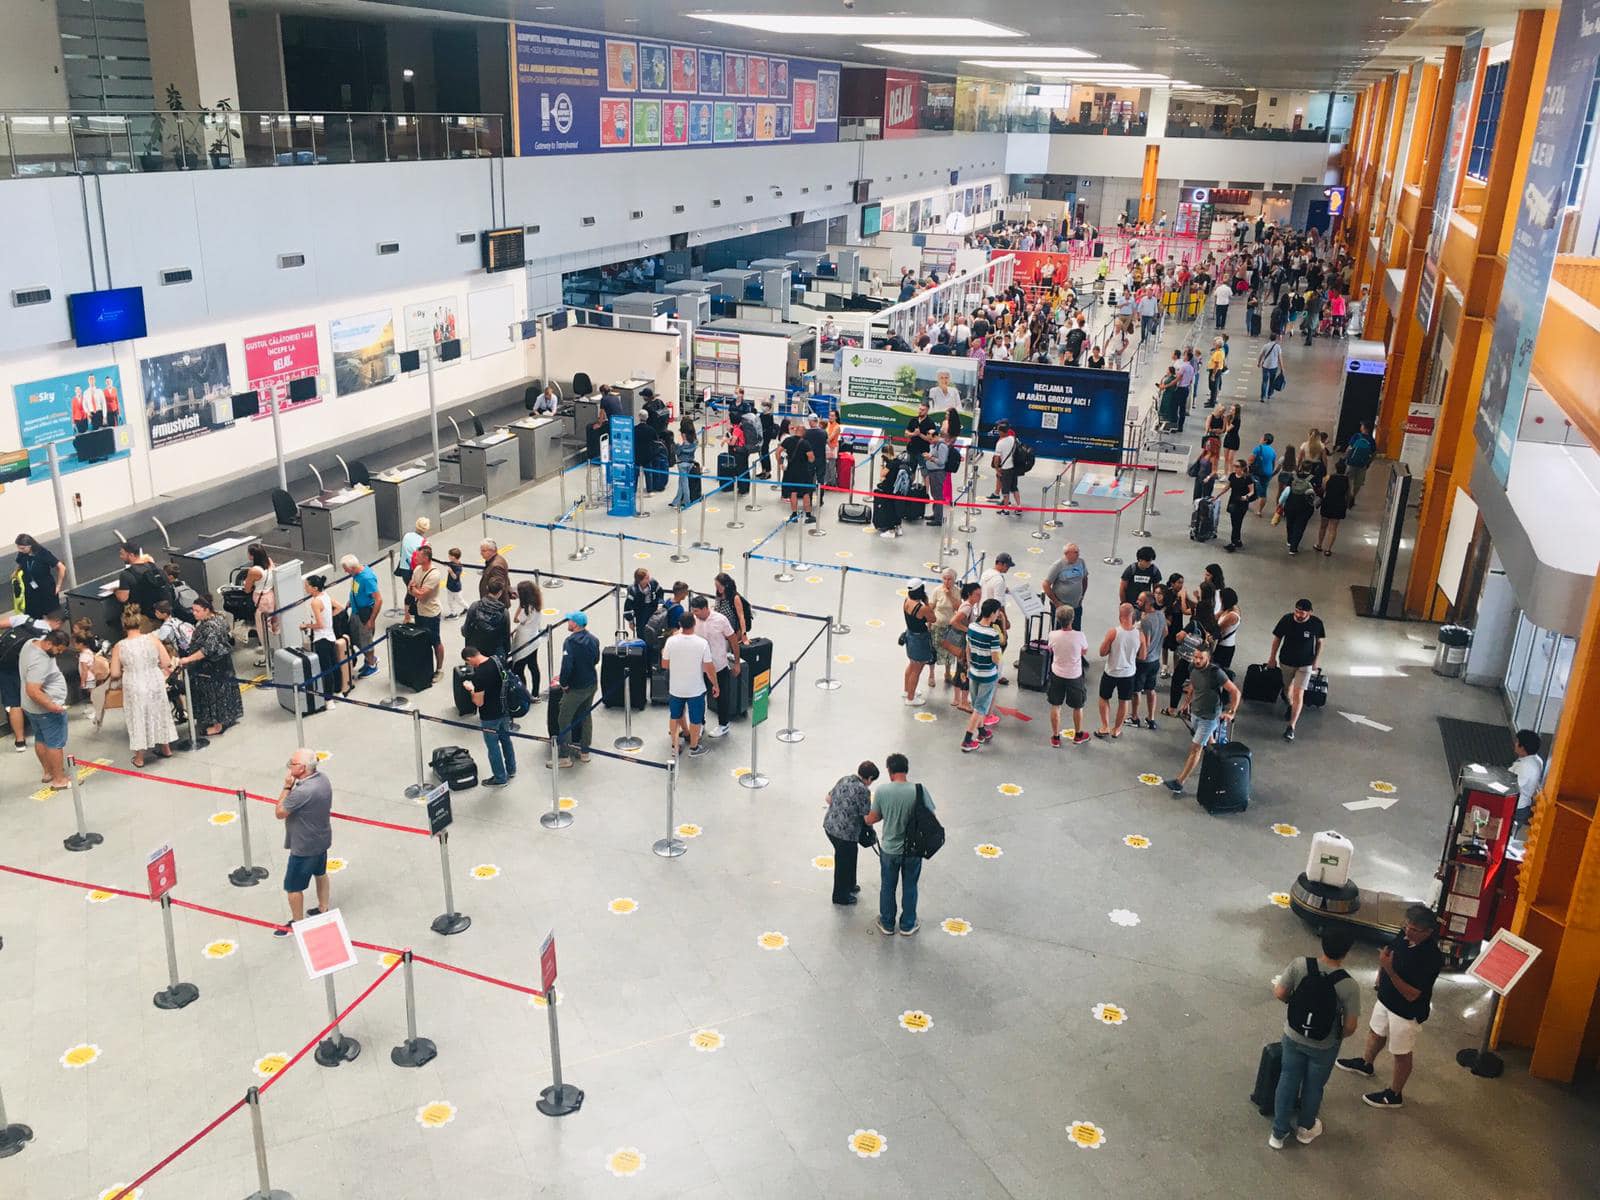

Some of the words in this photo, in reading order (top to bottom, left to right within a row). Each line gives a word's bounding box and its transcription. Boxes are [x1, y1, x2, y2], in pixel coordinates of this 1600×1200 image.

[246, 341, 268, 351] GUSTUL
[288, 344, 296, 352] LA
[1033, 383, 1065, 394] RECLAMA
[1065, 386, 1073, 394] TA
[1016, 392, 1026, 400] AR
[1047, 395, 1073, 405] GROZAV
[1073, 397, 1087, 406] AICI
[1028, 404, 1051, 412] CONNECT
[152, 413, 200, 439] #mustvisit
